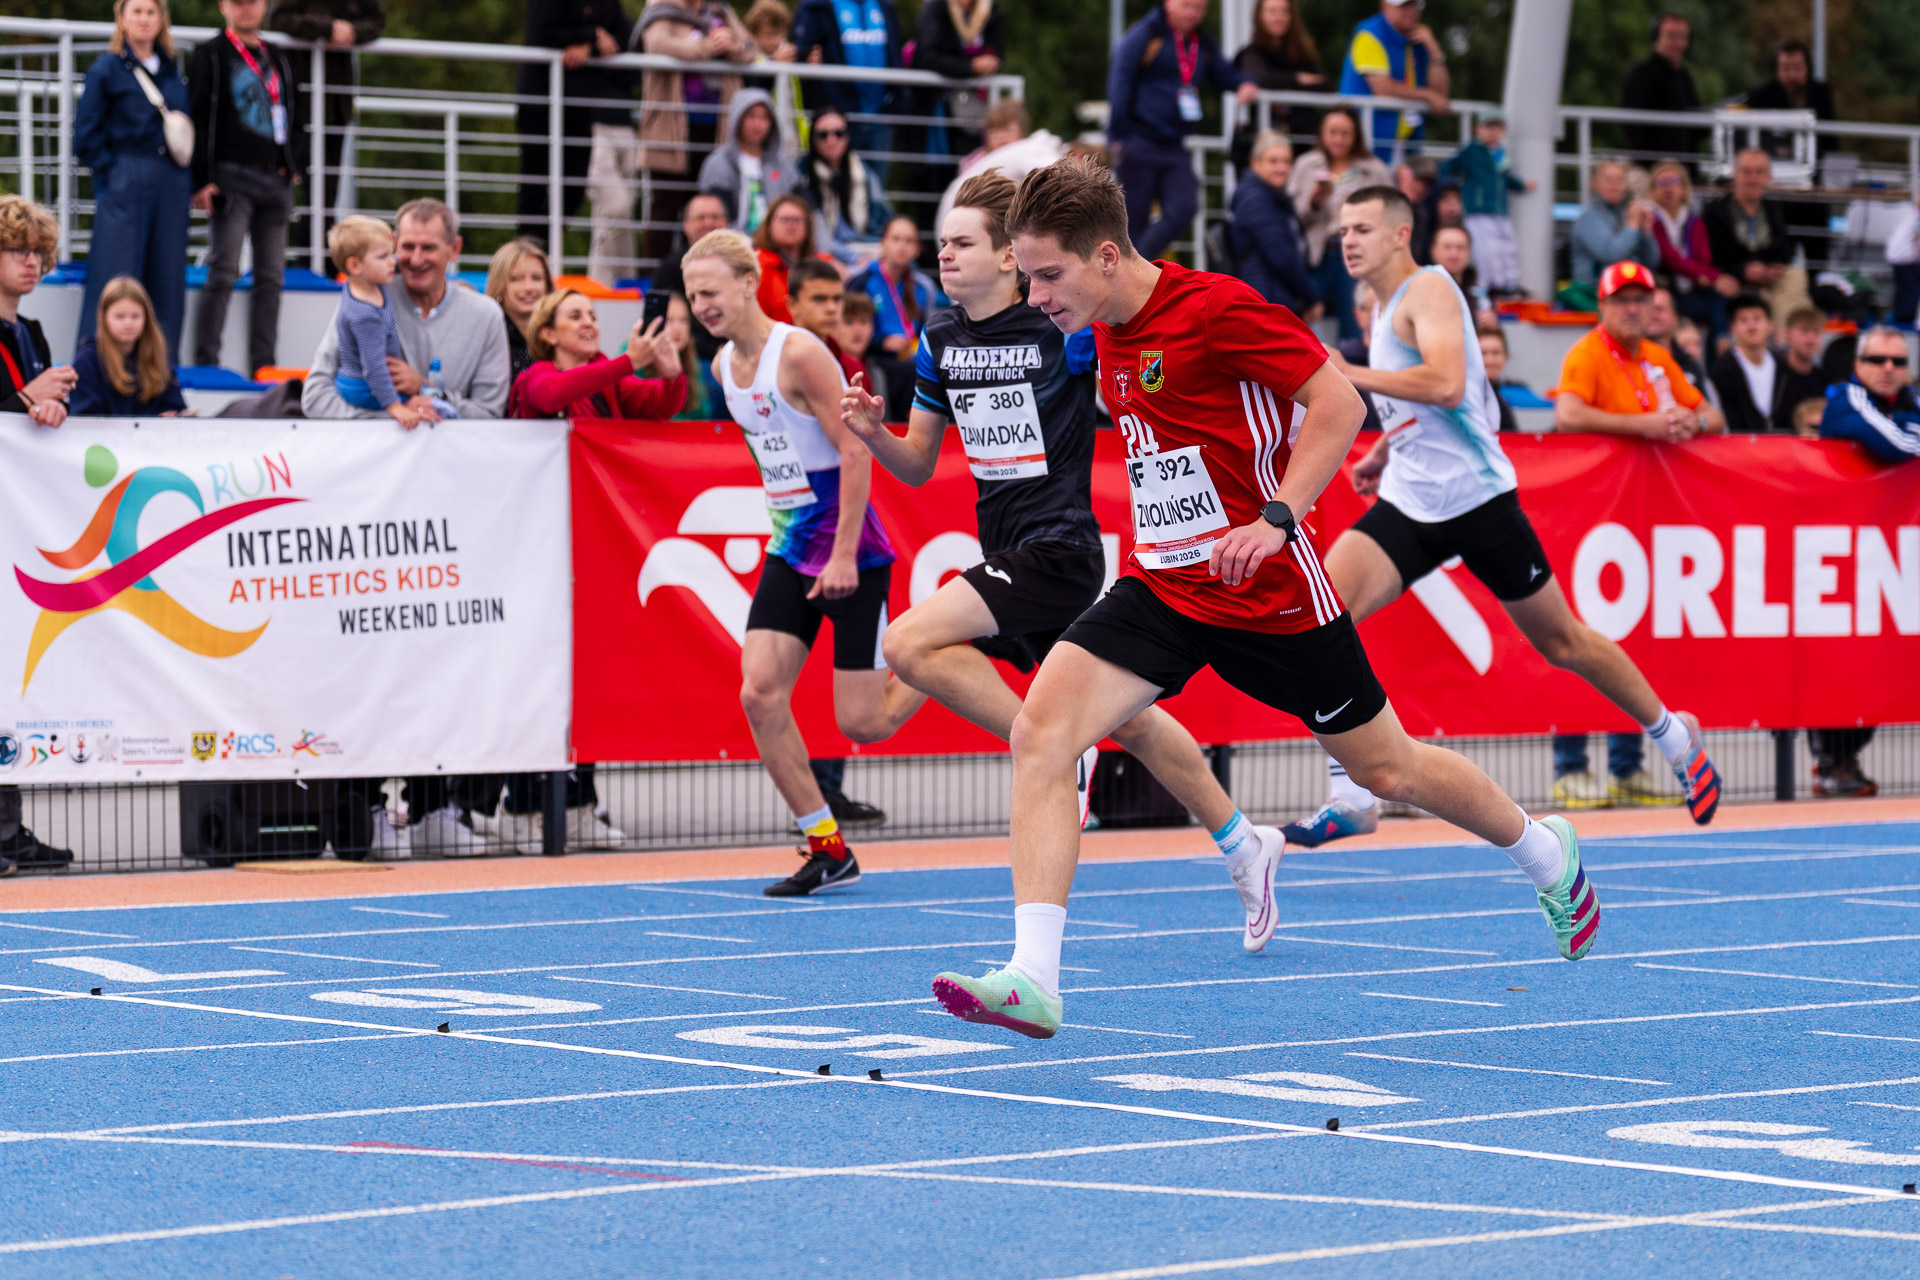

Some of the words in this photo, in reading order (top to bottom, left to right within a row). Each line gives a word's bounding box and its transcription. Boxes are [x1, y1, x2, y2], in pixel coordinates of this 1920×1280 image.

[941, 346, 1040, 369] AKADEMIA
[948, 367, 984, 380] SPORTU
[985, 366, 1026, 380] OTWOCK
[954, 392, 977, 414] 4F
[989, 390, 1025, 410] 380
[763, 436, 788, 452] 425
[960, 423, 1038, 447] ZAWADKA
[1119, 413, 1160, 459] 24
[206, 451, 292, 504] RUN
[1000, 466, 1019, 476] 2026
[1155, 455, 1196, 481] 392
[226, 518, 458, 568] INTERNATIONAL
[1160, 554, 1179, 564] LUBIN
[1179, 549, 1201, 562] 2026
[229, 569, 387, 603] ATHLETICS
[396, 563, 460, 592] KIDS
[1572, 522, 1920, 642] ORLEN
[339, 602, 437, 635] WEEKEND
[445, 597, 505, 627] LUBIN
